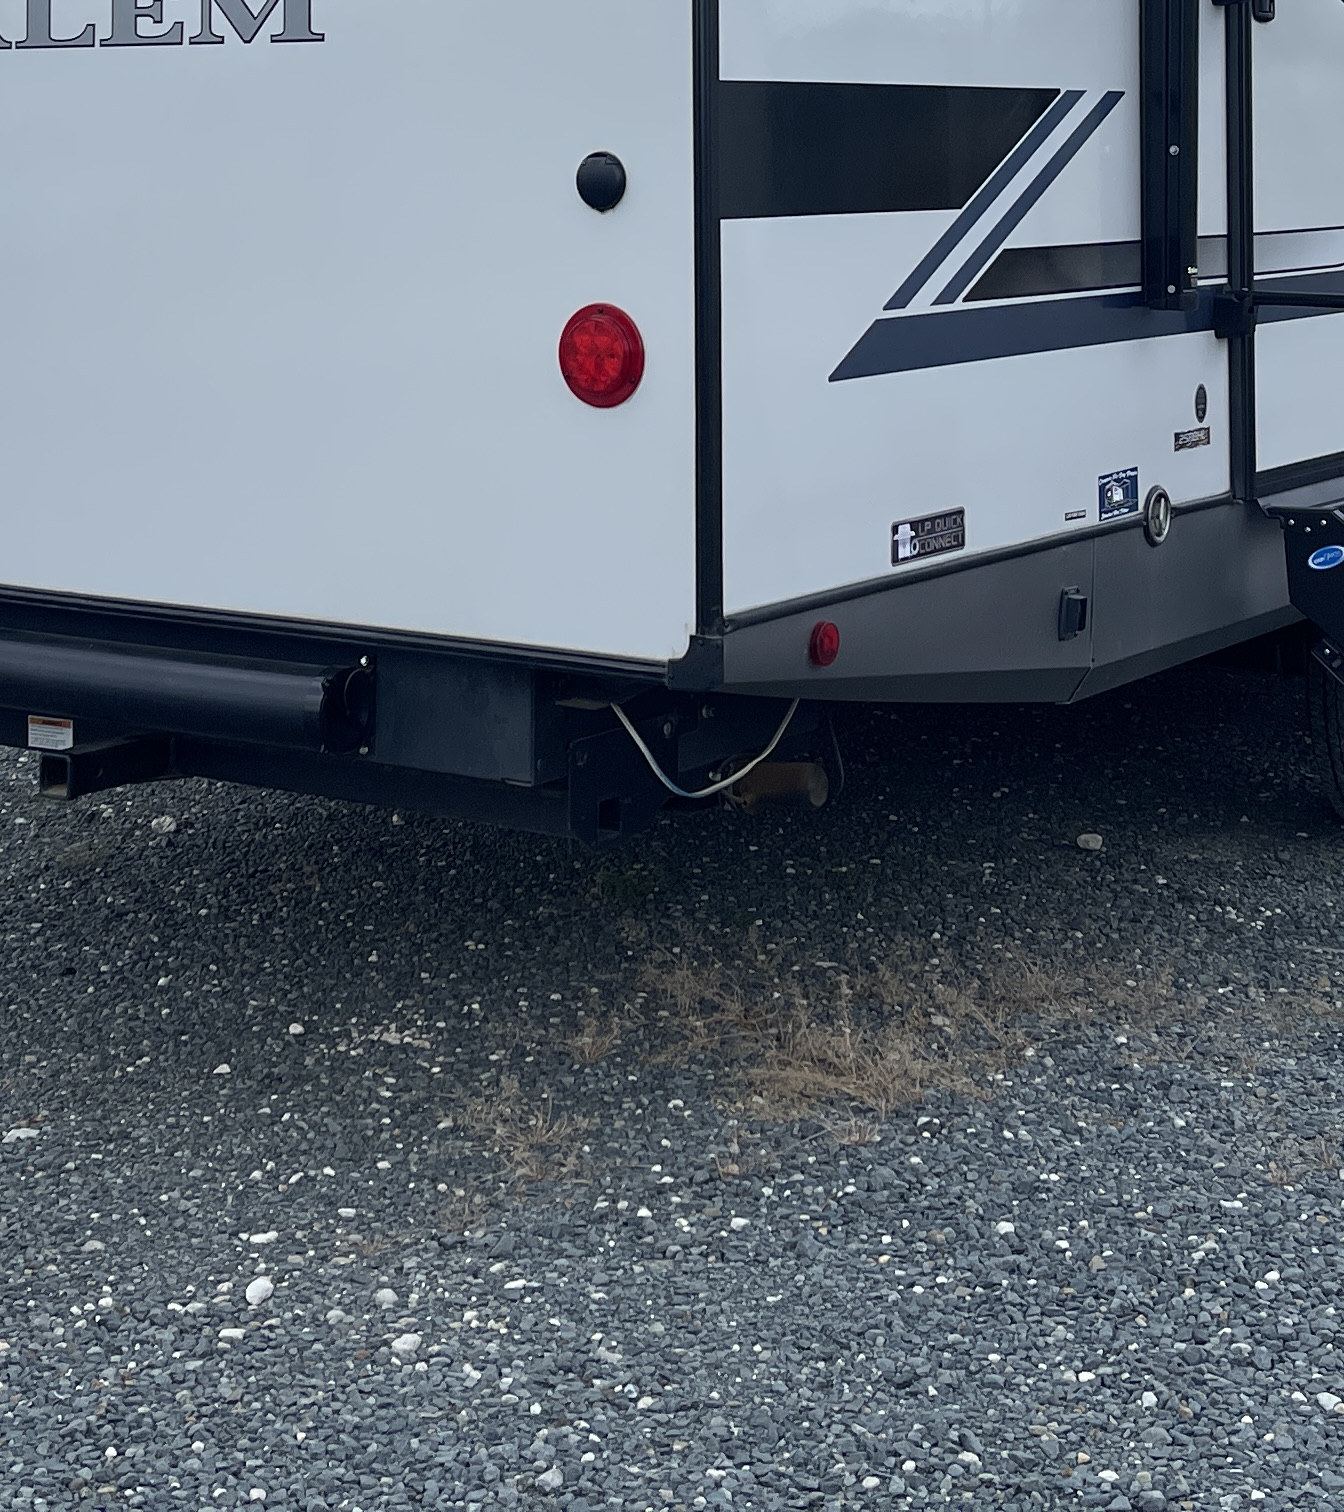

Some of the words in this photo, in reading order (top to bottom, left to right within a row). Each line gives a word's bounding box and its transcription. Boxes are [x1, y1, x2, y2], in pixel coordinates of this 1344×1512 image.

[918, 521, 932, 536] LP
[934, 514, 963, 532] QUICK
[919, 531, 963, 554] CONNECT
